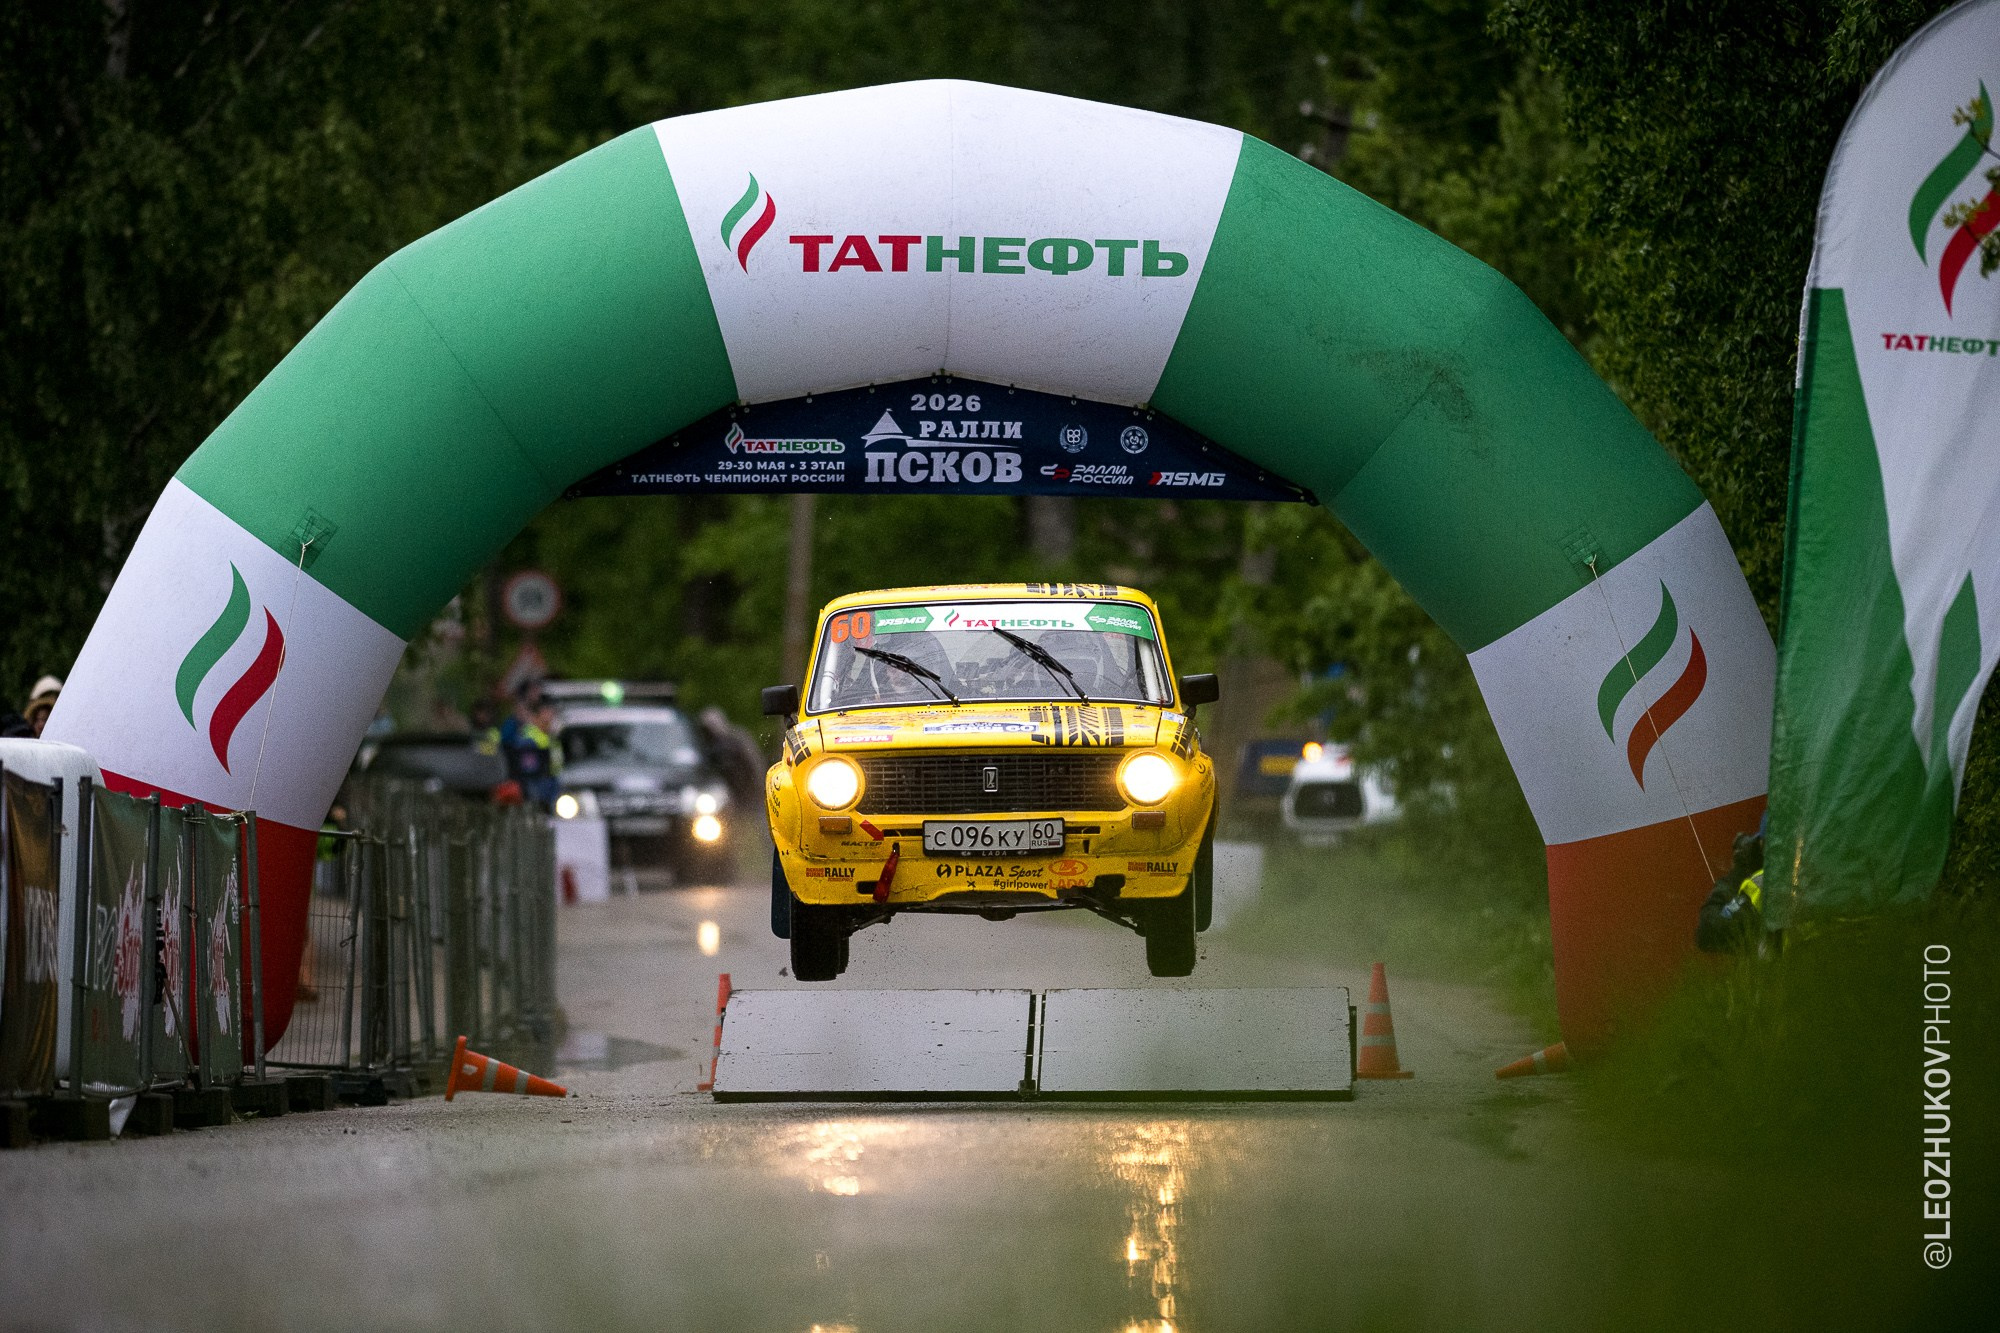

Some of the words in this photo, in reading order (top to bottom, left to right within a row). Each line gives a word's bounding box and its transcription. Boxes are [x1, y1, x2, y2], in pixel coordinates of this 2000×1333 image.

[789, 235, 1190, 277] ТАТНЕФТЬ
[910, 393, 982, 412] 2026
[919, 420, 1023, 439] РАЛЛИ
[744, 440, 845, 453] ТАТНЕФТЬ
[717, 461, 753, 470] 29-30
[757, 461, 786, 470] МАЯ
[799, 461, 807, 470] 3
[810, 461, 845, 470] ЭТАП
[864, 451, 1023, 483] ПСКОВ
[1072, 464, 1128, 475] РАЛЛИ
[631, 474, 701, 483] ТАТНЕФТЬ
[704, 474, 788, 483] ЧЕМПИОНАТ
[791, 474, 845, 483] РОССИИ
[1069, 474, 1135, 485] РОССИИ
[1154, 472, 1227, 486] ASMG
[830, 611, 871, 644] 60
[963, 618, 1075, 628] ТАТНЕФТЬ
[838, 735, 890, 743] MOTUL
[1032, 823, 1054, 839] 60
[1031, 839, 1048, 847] RUS
[824, 867, 856, 878] RALLY
[955, 865, 1005, 877] PLAZA
[1008, 865, 1044, 878] Sport
[1146, 861, 1179, 873] RALLY
[993, 879, 1048, 890] #girlpower
